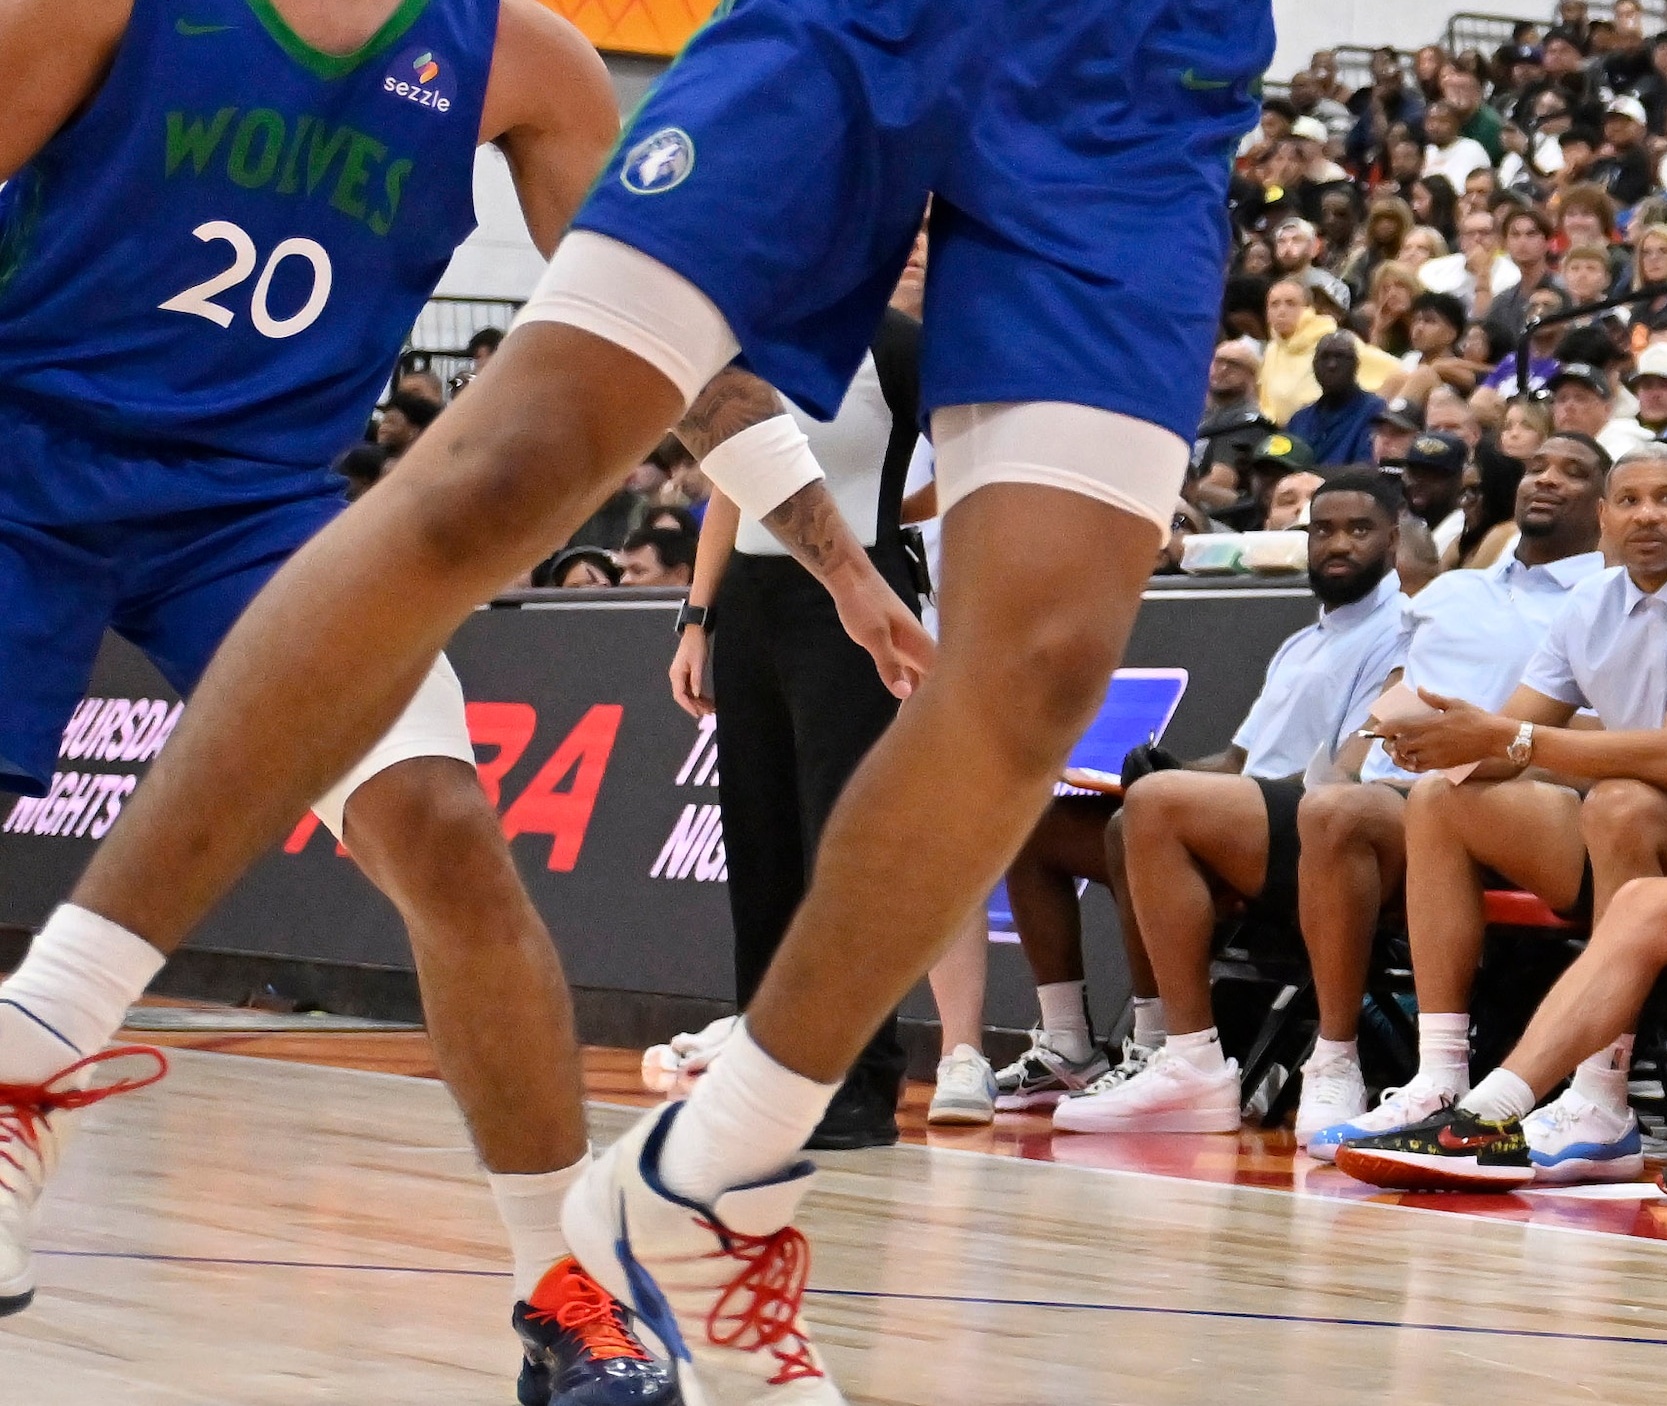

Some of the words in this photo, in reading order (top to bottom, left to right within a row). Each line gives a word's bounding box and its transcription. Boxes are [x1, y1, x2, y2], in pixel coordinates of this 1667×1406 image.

[383, 76, 452, 113] sezzle
[157, 220, 333, 339] 20
[58, 697, 186, 763] HURSDA
